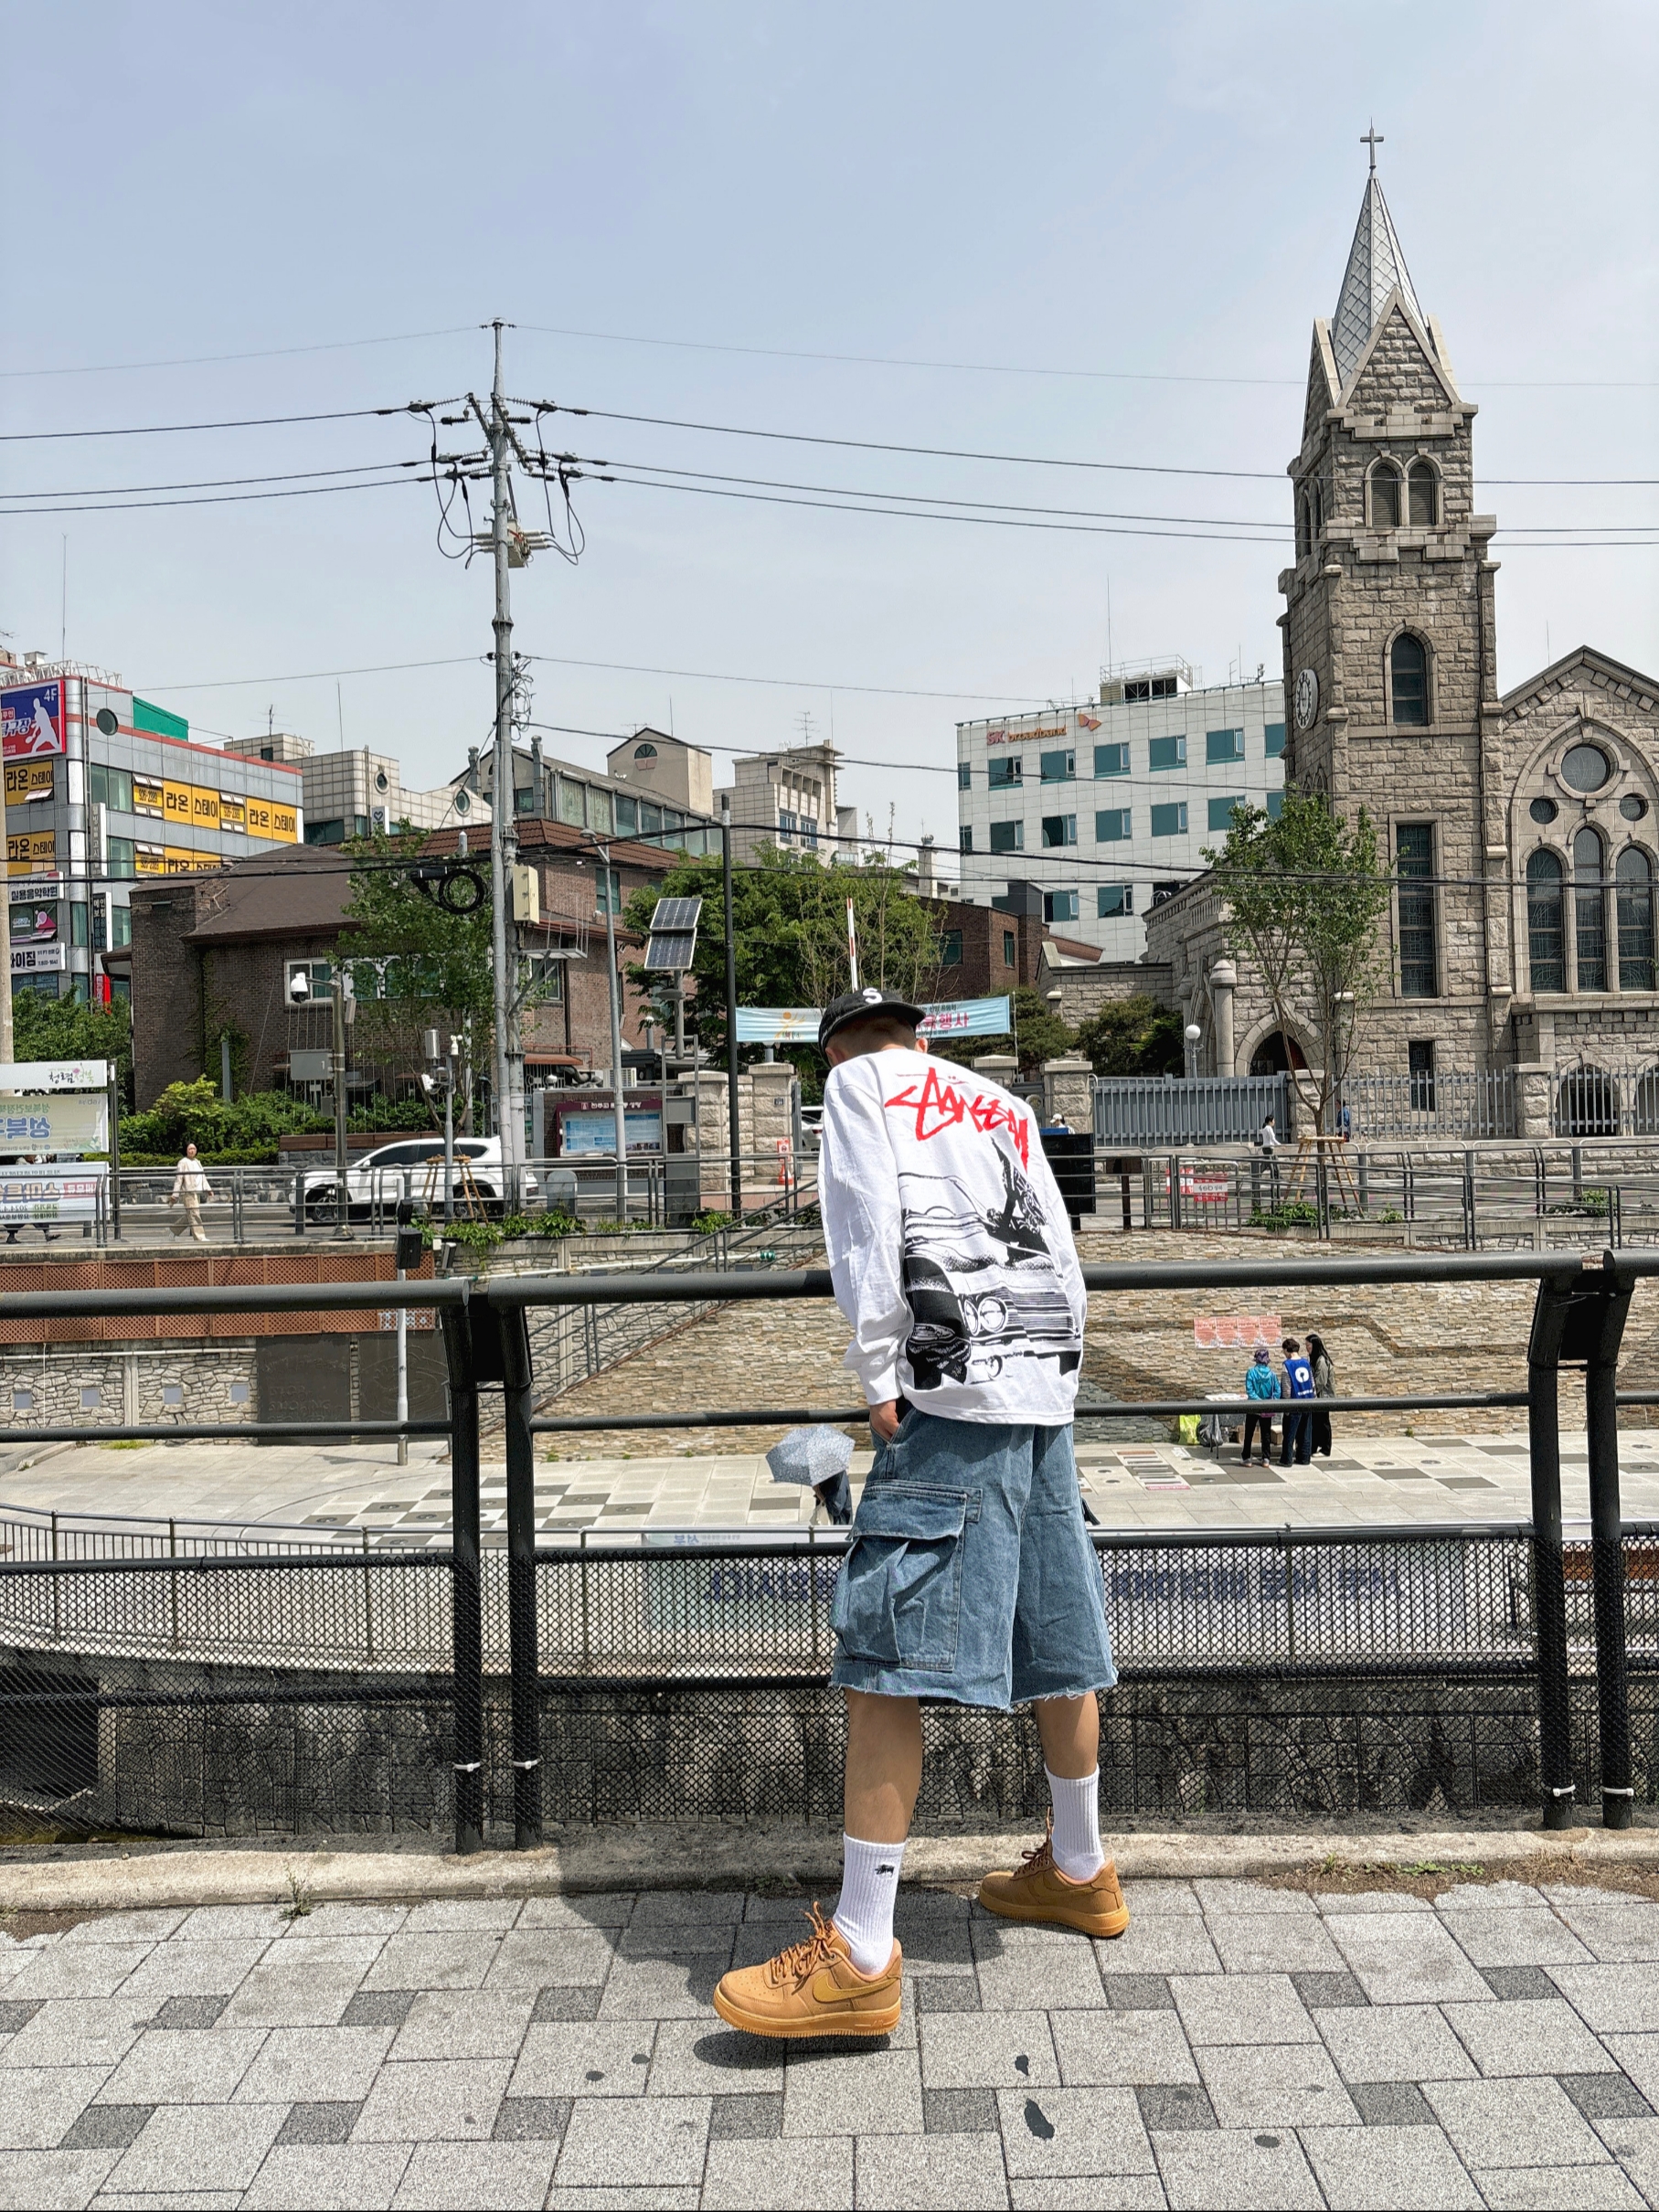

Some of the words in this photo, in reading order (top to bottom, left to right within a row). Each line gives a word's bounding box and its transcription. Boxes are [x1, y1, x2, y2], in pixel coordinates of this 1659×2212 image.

[44, 688, 57, 701] 4F
[986, 730, 1005, 745] SK
[1007, 724, 1068, 743] broadband
[6, 769, 28, 792] 라온
[31, 770, 54, 785] 스테이
[166, 792, 189, 813] 라온
[195, 797, 218, 818] 스테이
[250, 808, 270, 828] 라온
[274, 814, 296, 833] 스테이
[8, 838, 30, 861] 라온
[33, 840, 55, 856] 스테이
[863, 987, 883, 1005] S
[916, 1012, 970, 1031] 육행사
